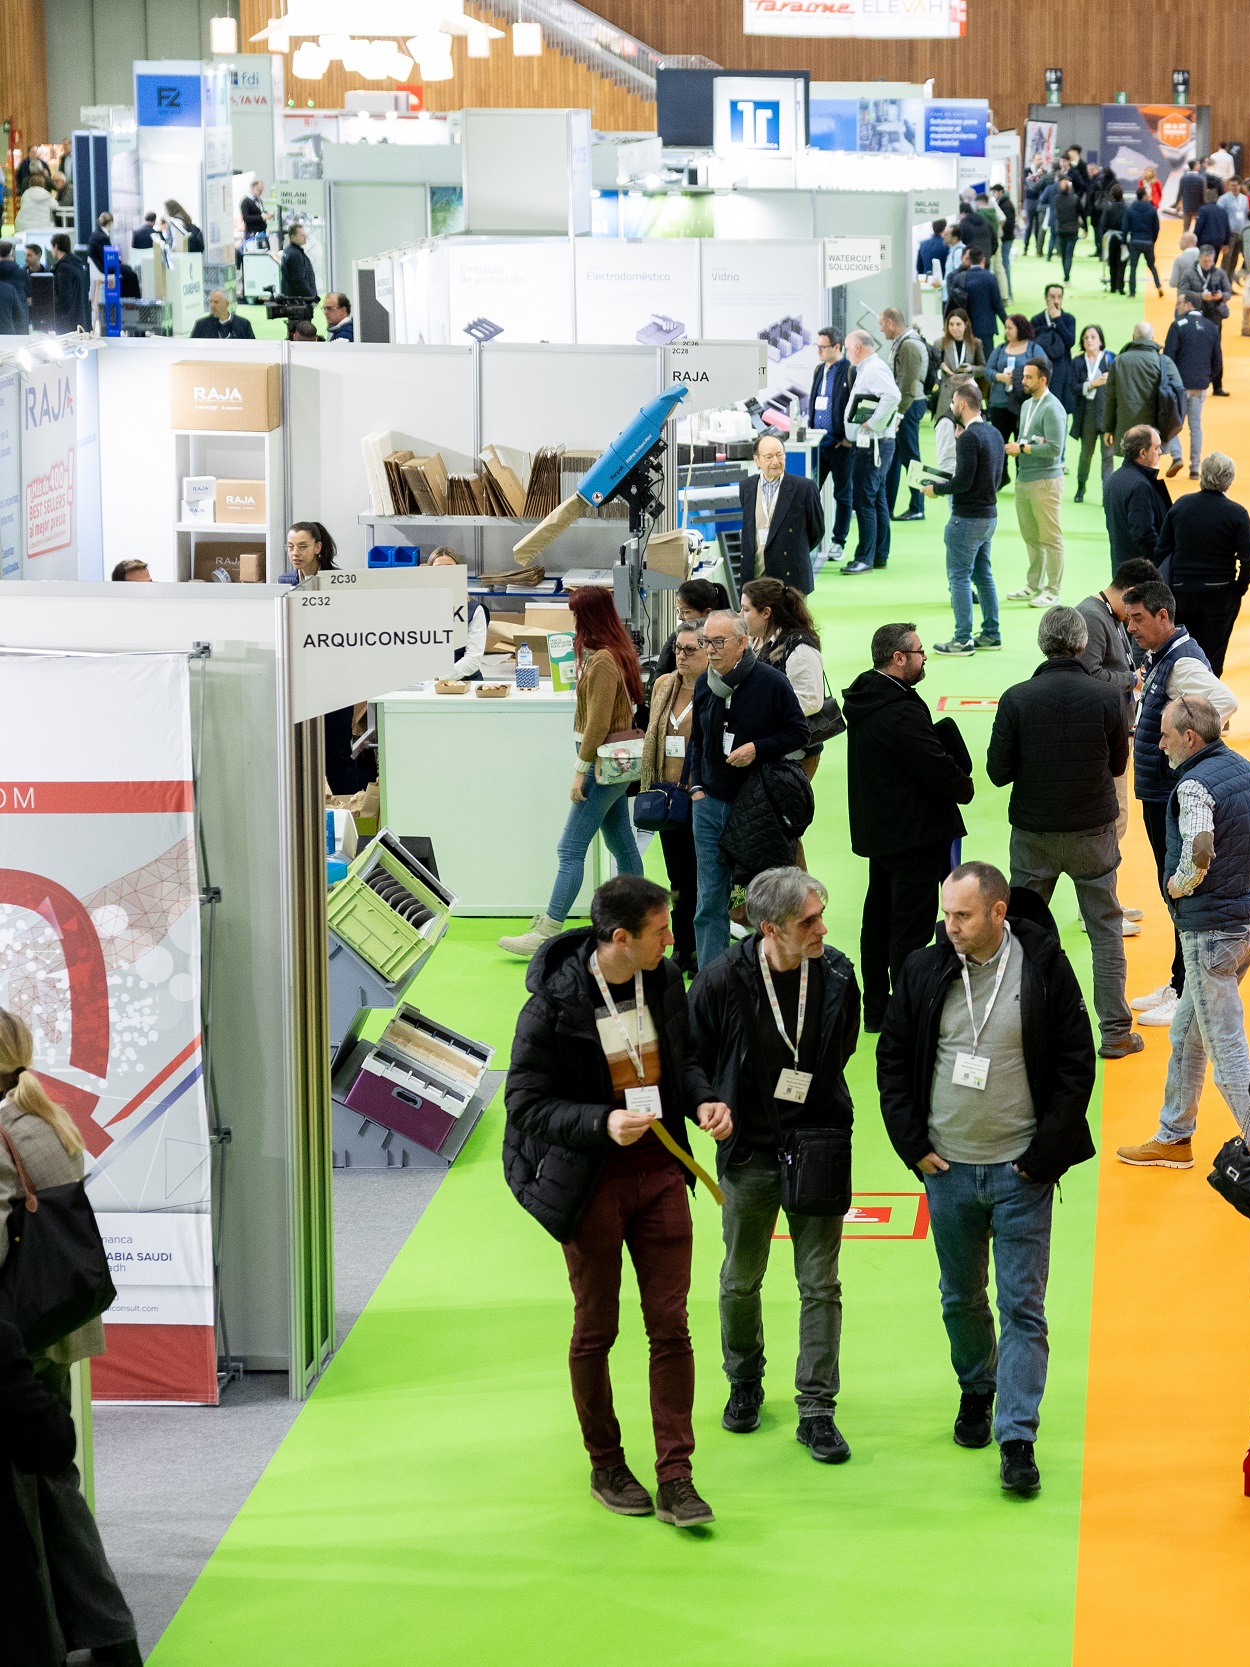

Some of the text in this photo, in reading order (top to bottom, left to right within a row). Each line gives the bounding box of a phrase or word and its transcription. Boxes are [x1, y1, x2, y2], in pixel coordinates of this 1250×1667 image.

[828, 253, 872, 263] WATERCUT
[828, 263, 880, 272] SOLUCIONES
[586, 271, 671, 281] Electrodoméstico
[711, 271, 740, 281] Vidrio
[672, 370, 710, 383] RAJA
[193, 386, 243, 401] RAJA
[25, 375, 74, 431] RAJA
[226, 495, 255, 505] RAJA
[215, 556, 241, 565] RAJ
[330, 574, 357, 584] 2C30
[302, 597, 331, 607] 2C32
[303, 629, 453, 649] ARQUICONSULT
[106, 1252, 172, 1262] ABIA SAUDI
[108, 1263, 127, 1272] adh
